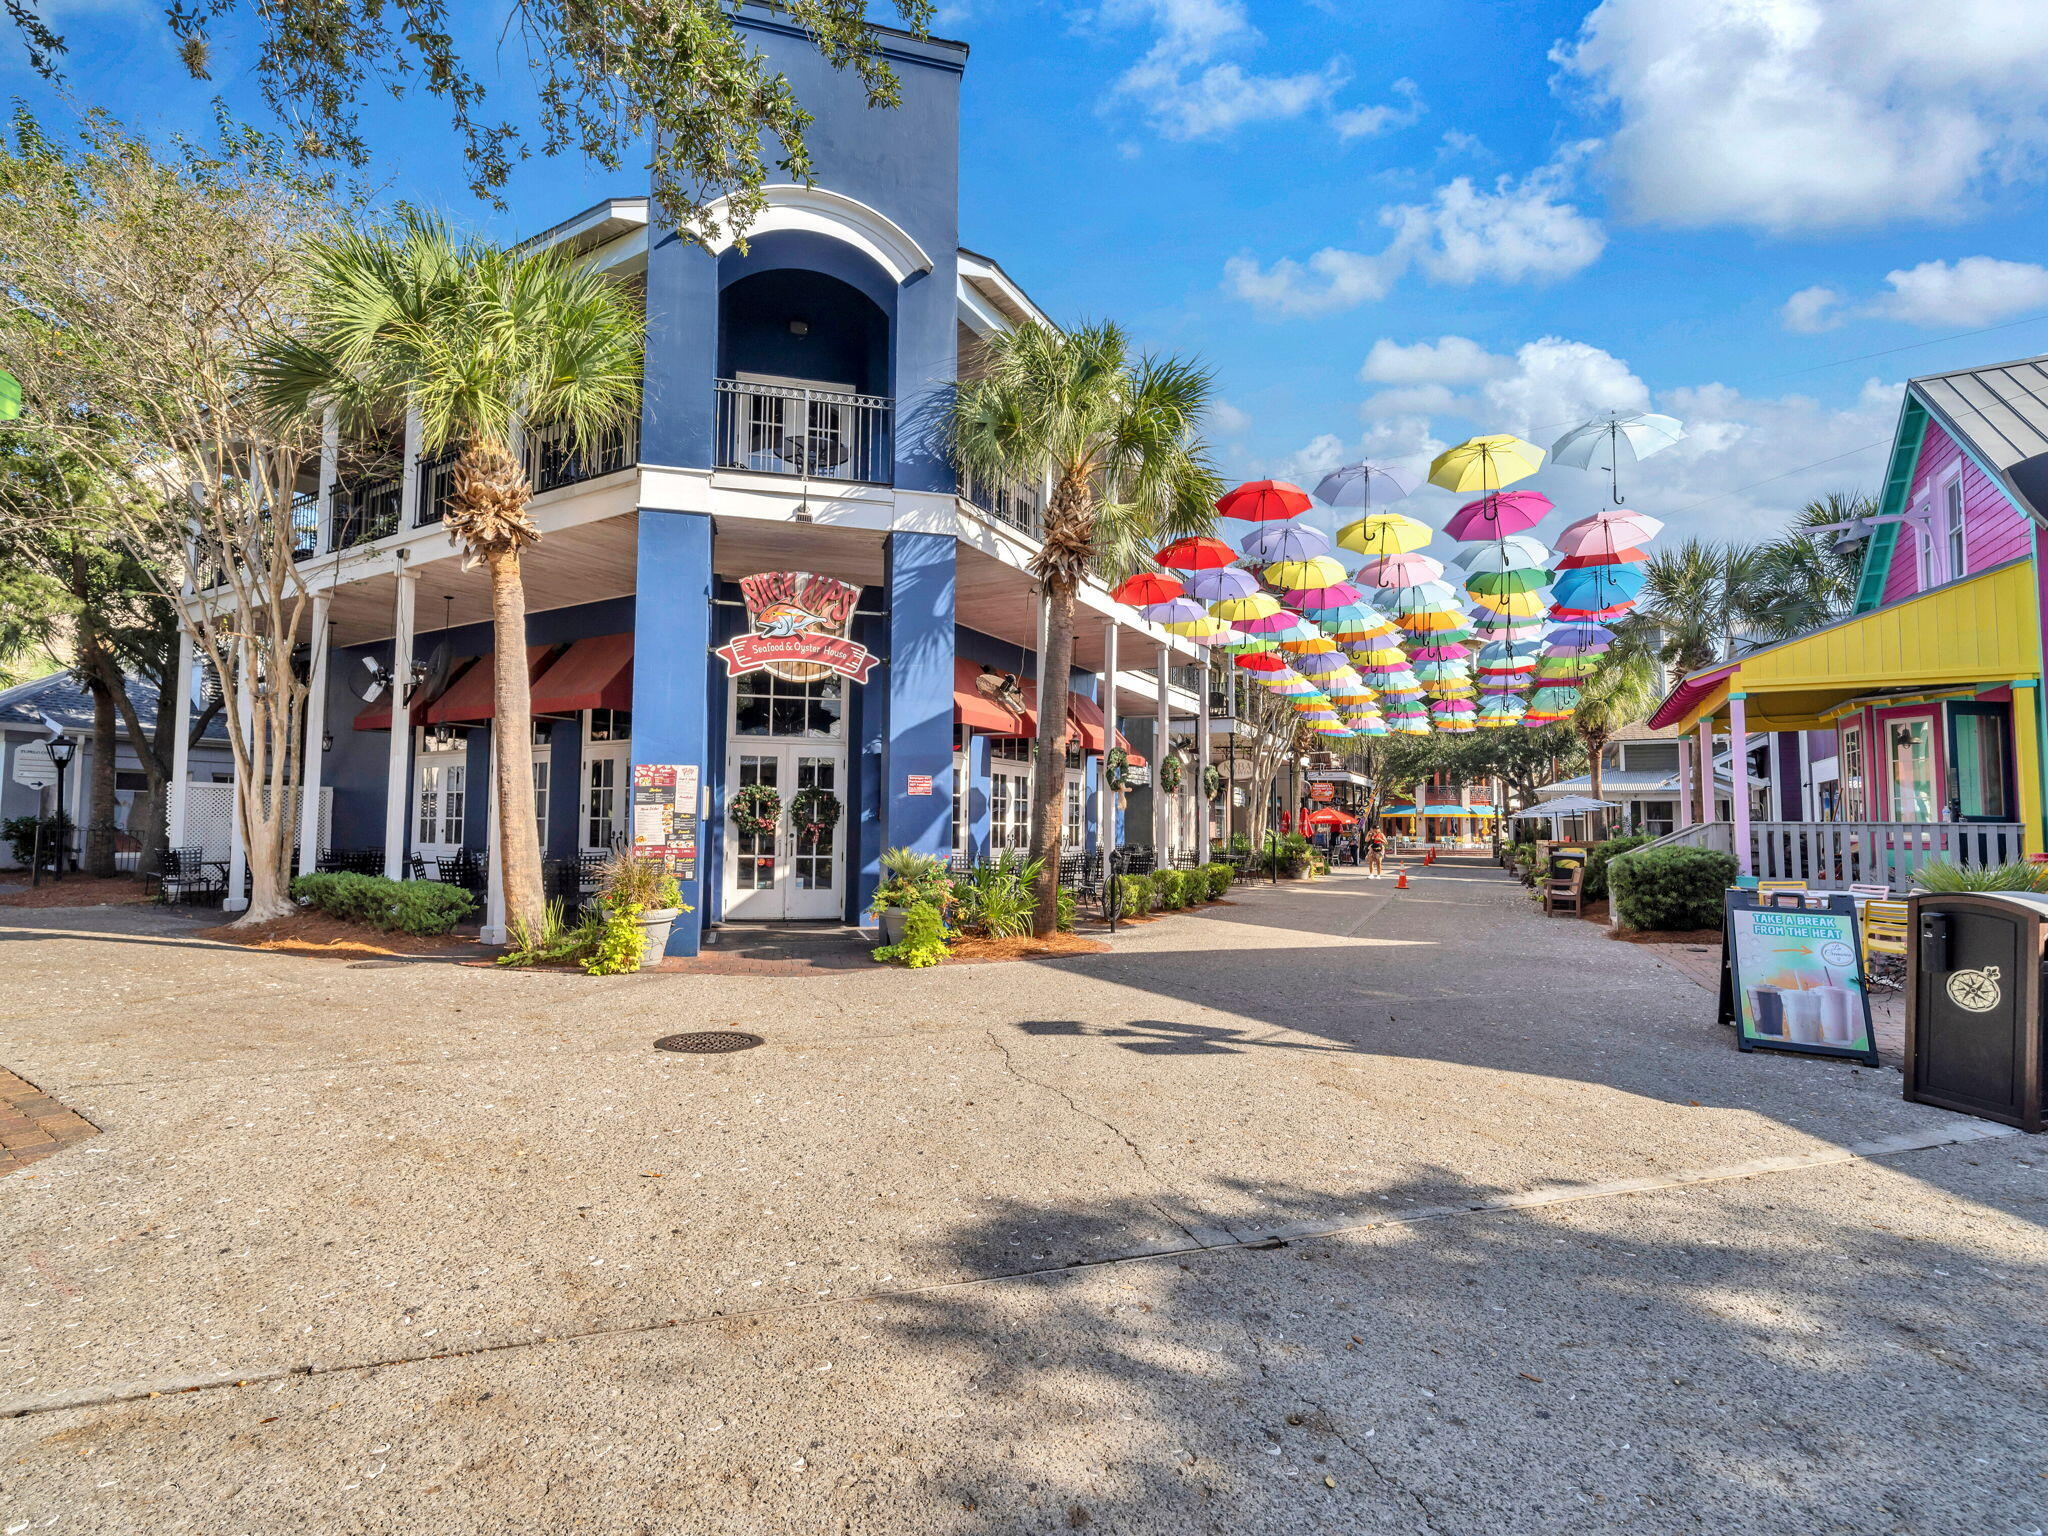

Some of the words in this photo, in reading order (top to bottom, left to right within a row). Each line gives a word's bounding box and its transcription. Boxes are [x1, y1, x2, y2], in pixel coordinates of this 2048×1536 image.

[741, 571, 797, 613] SLICK
[800, 572, 857, 620] LIPS
[752, 641, 784, 654] Seafood
[786, 642, 793, 651] &
[794, 641, 820, 654] Oyster
[823, 646, 847, 659] House
[1753, 913, 1782, 924] TAKE
[1786, 915, 1794, 925] A
[1796, 916, 1836, 927] BREAK
[1754, 925, 1784, 936] FROM
[1787, 927, 1809, 937] THE
[1812, 929, 1842, 939] HEAT
